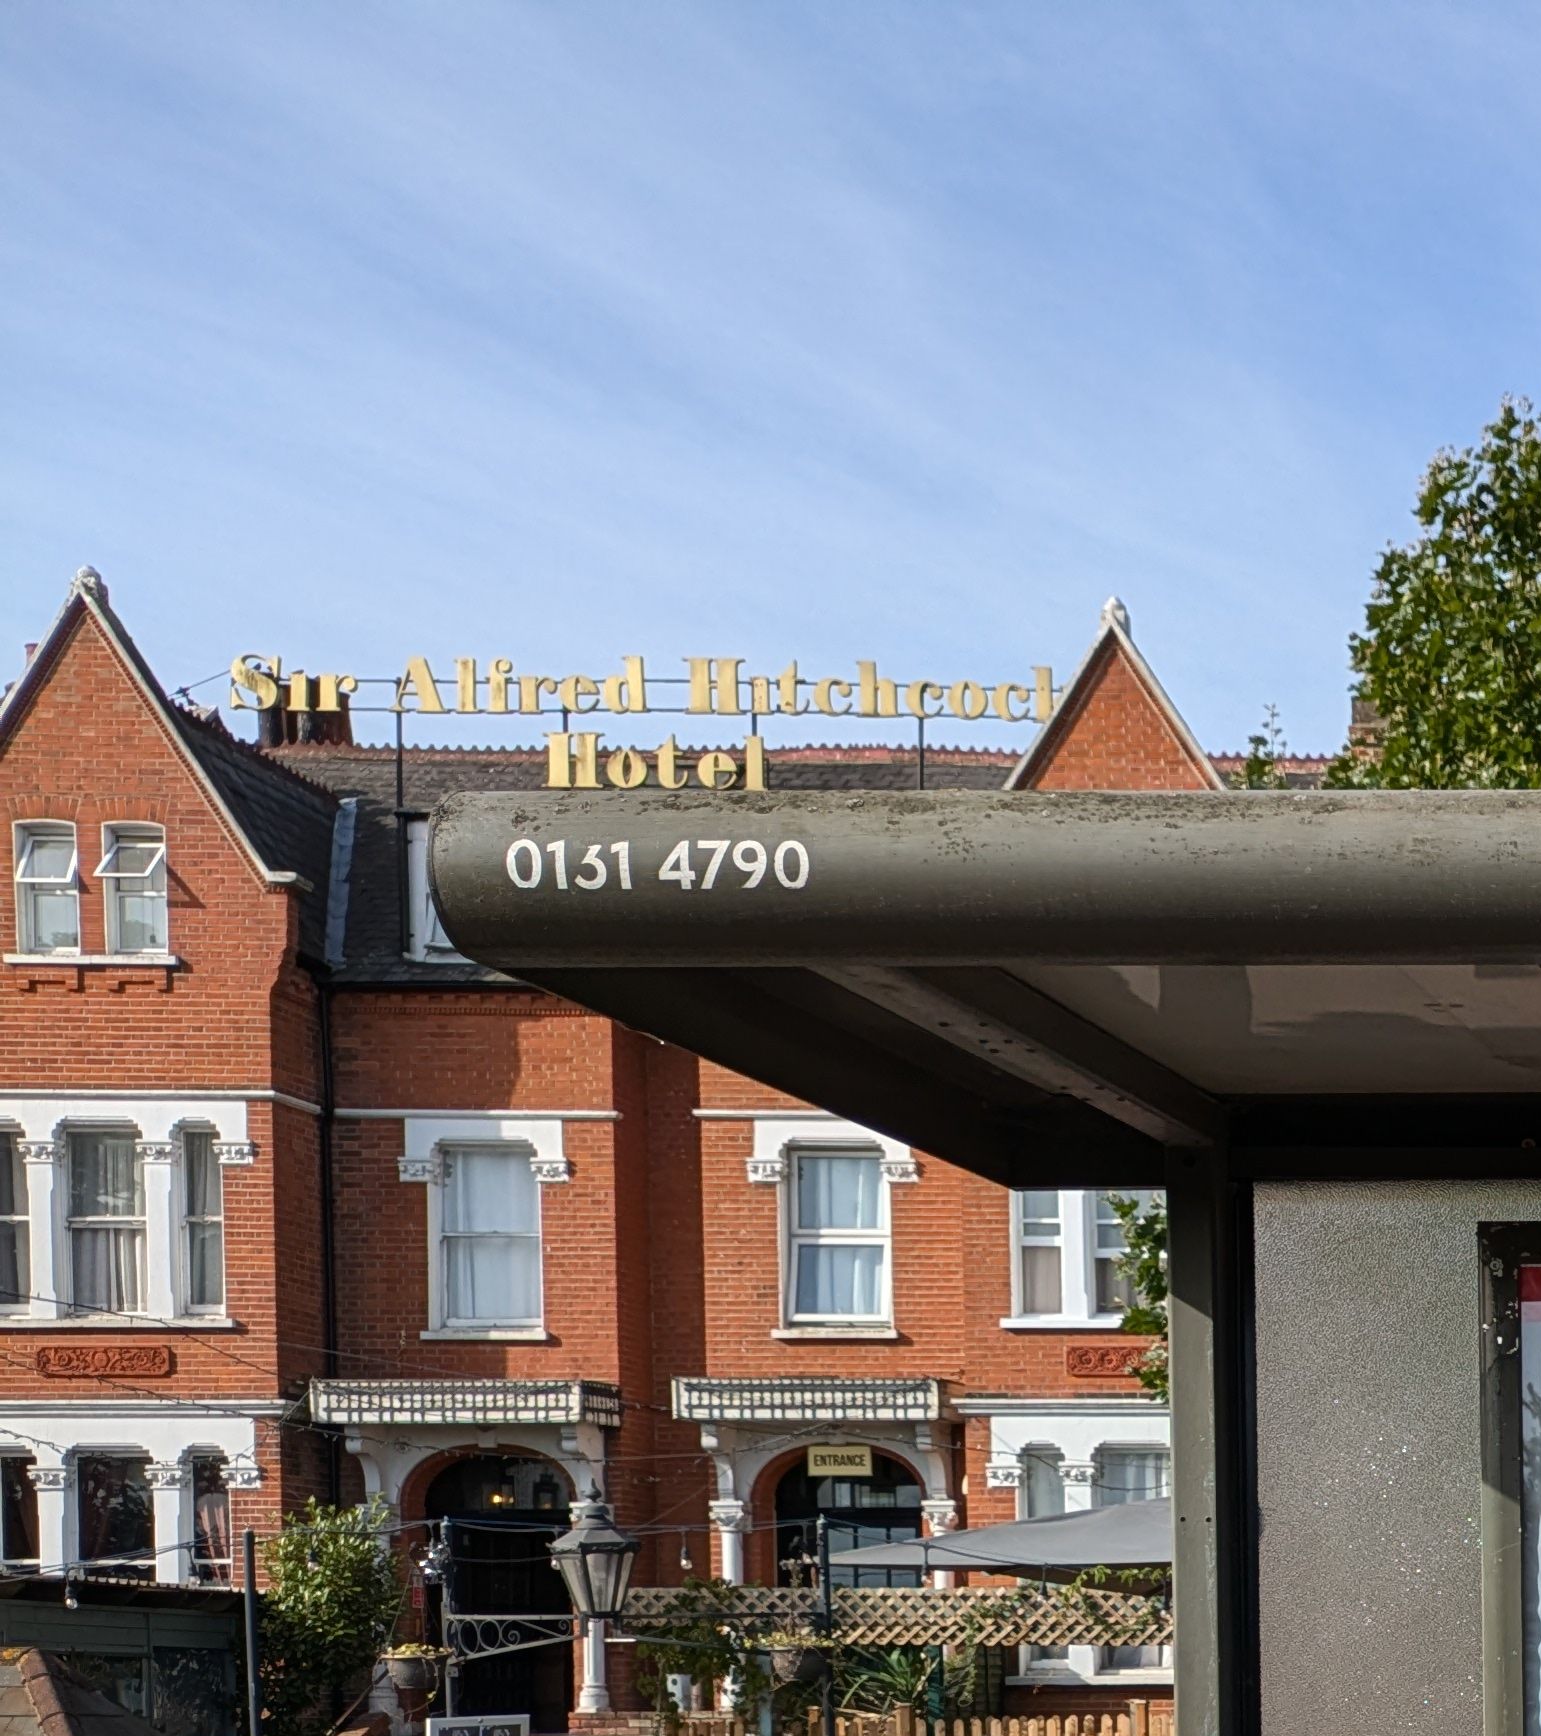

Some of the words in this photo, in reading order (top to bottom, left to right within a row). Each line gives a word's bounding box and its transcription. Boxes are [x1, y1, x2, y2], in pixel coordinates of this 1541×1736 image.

[230, 654, 358, 712] Sir
[389, 656, 647, 715] Alfred
[542, 732, 768, 791] Hotel
[506, 838, 632, 890] 0131
[658, 839, 810, 890] 4790
[813, 1454, 866, 1467] ENTRANCE
